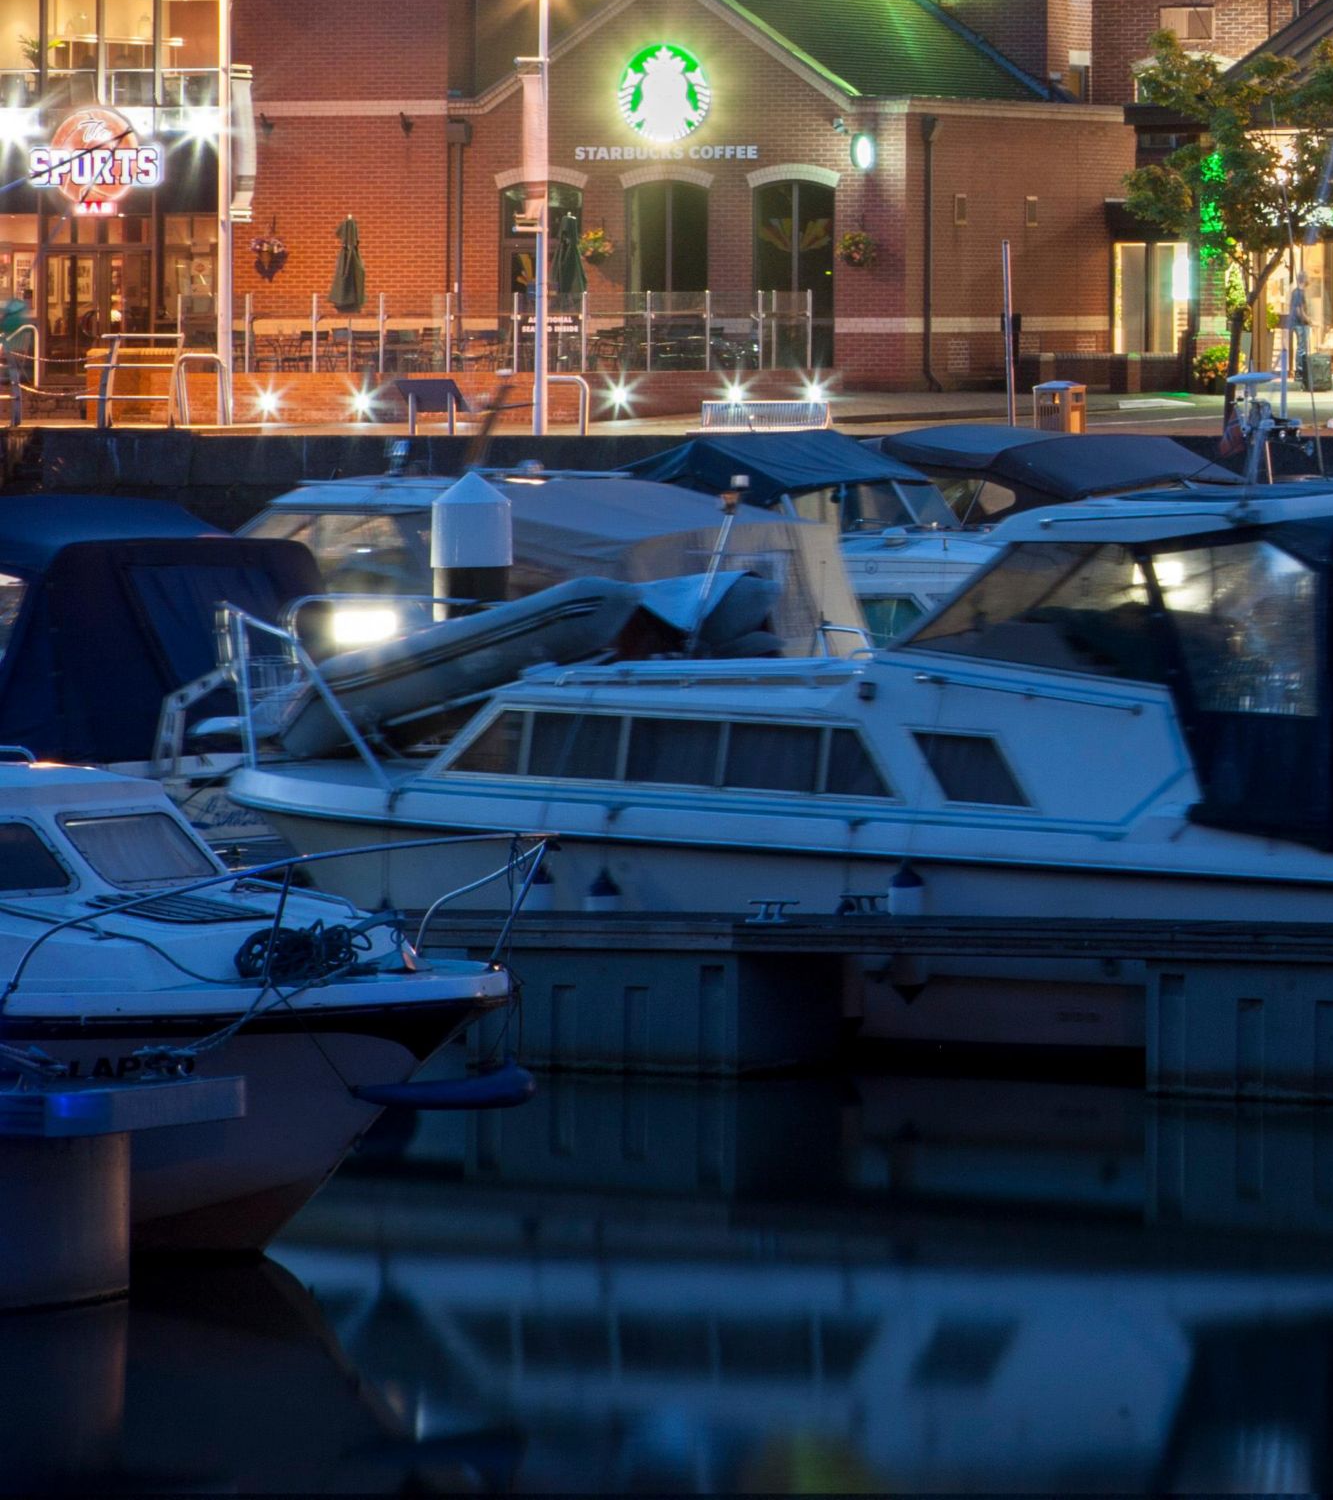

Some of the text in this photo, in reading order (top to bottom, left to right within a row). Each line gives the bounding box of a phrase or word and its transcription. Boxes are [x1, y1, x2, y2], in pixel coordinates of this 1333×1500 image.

[575, 145, 759, 160] STARBUCKS COFFEE
[29, 147, 161, 187] SPORTS
